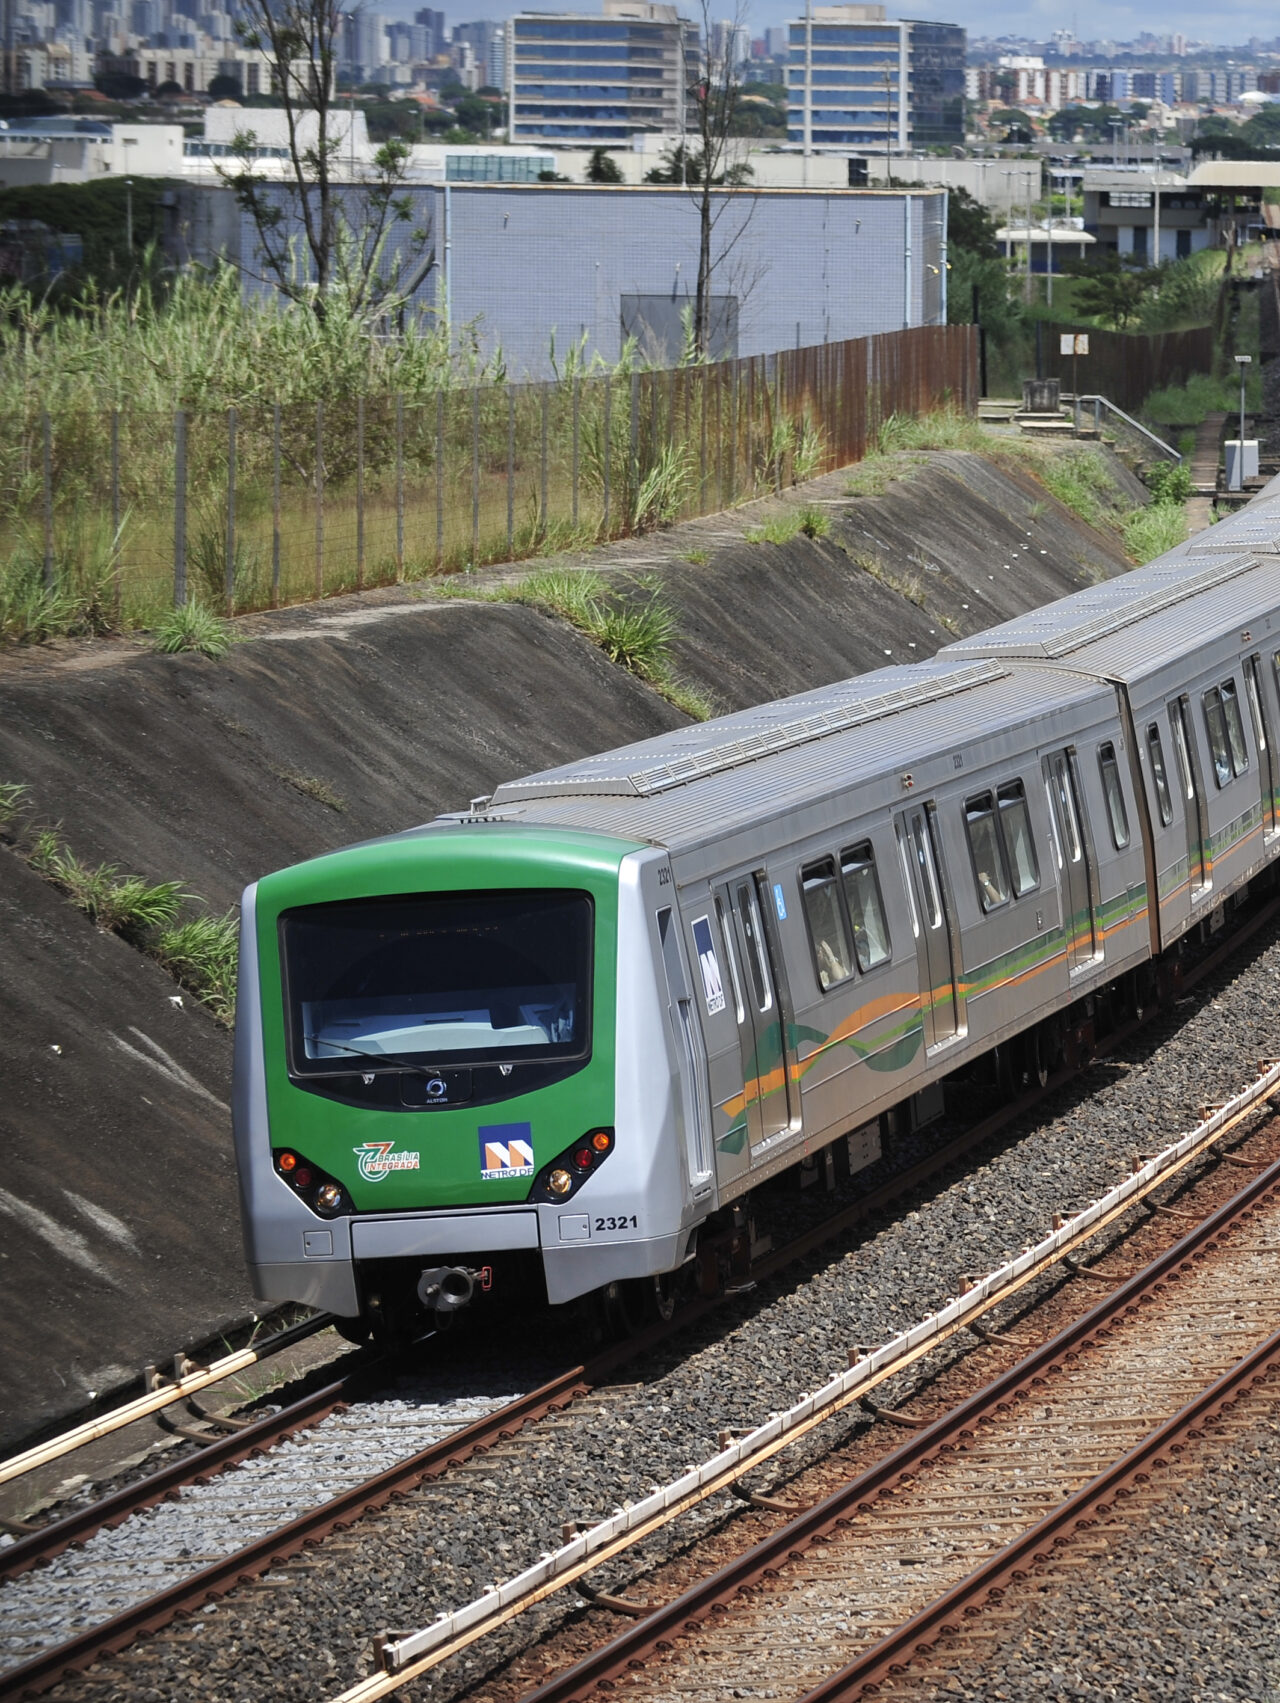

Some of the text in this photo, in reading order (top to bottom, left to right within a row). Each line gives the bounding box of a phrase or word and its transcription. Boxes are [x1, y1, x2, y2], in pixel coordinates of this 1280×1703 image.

[657, 866, 672, 886] 2321
[378, 1151, 419, 1163] BRASÍLIA
[366, 1161, 419, 1172] INTEGRADA
[519, 1168, 534, 1177] DF
[595, 1215, 638, 1231] 2321
